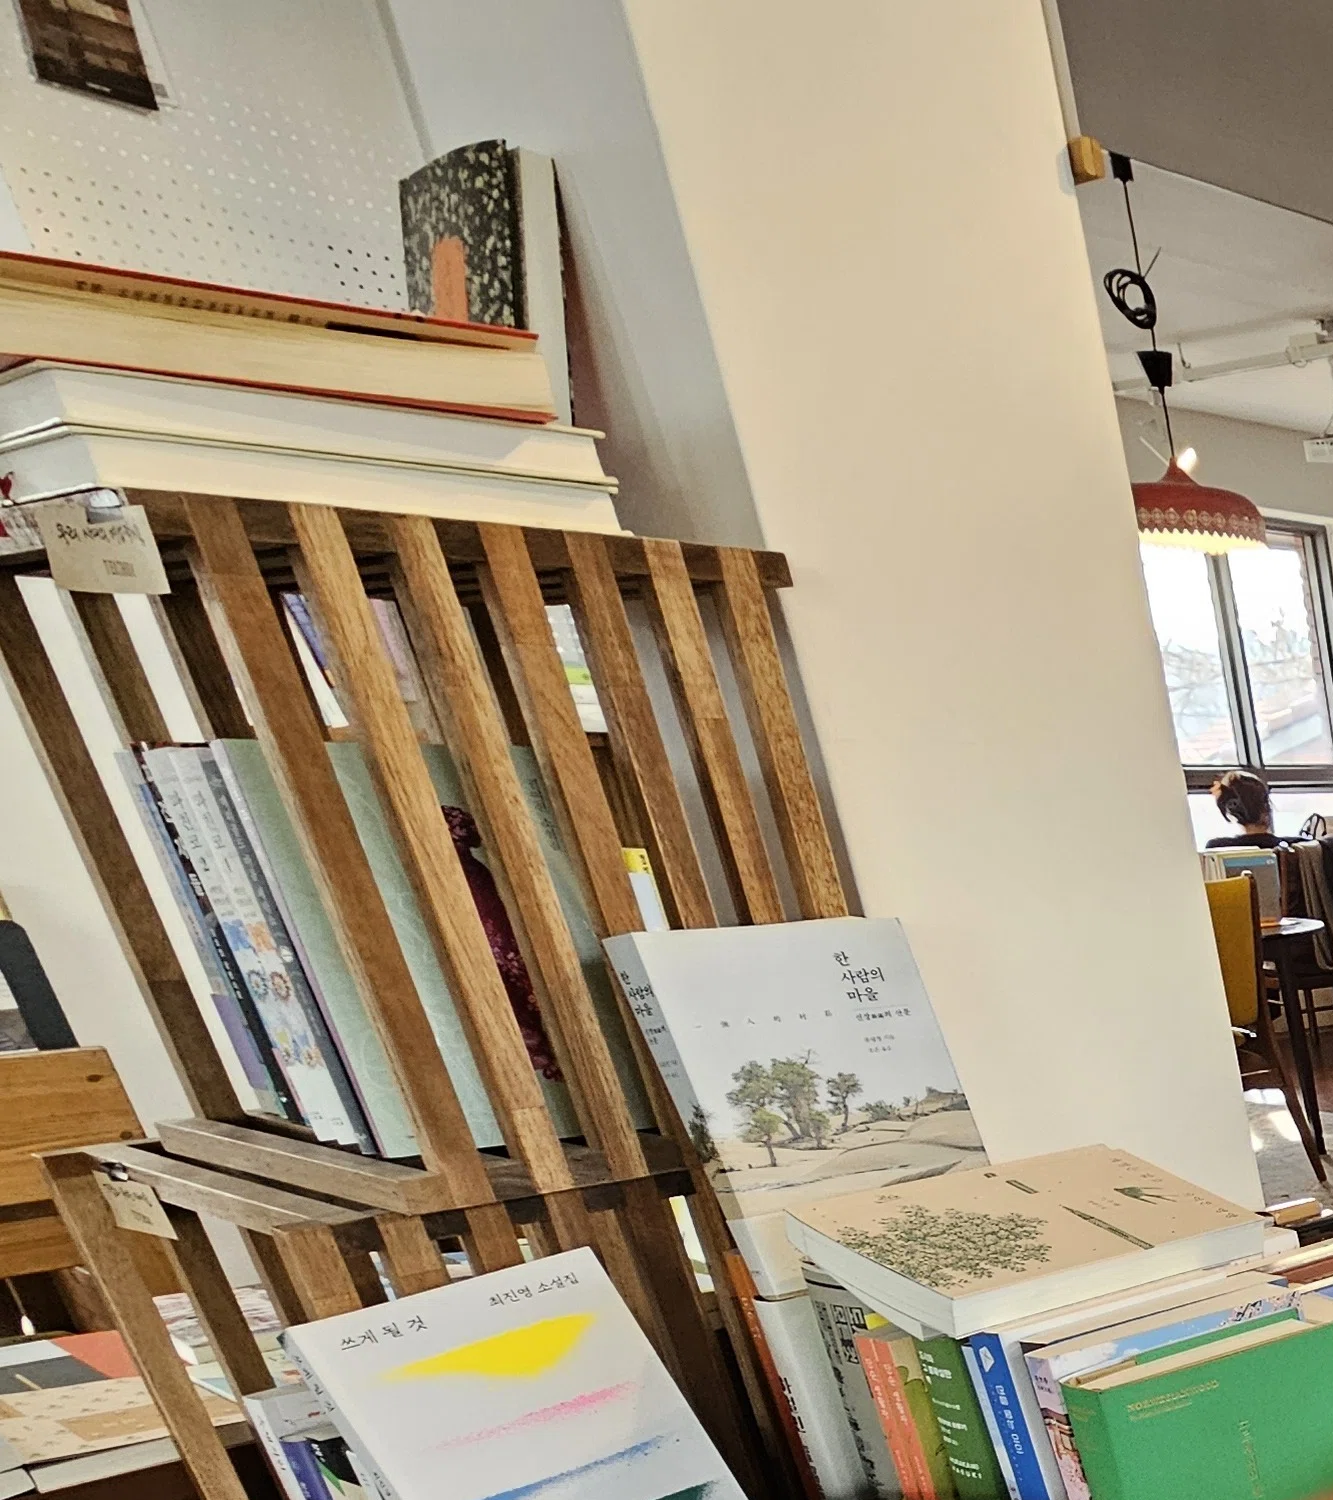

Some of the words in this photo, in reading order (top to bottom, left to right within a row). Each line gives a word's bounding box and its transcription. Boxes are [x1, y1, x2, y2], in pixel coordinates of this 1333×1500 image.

[833, 951, 850, 966] 한
[841, 967, 885, 985] 사람의
[847, 987, 878, 1003] 마을
[489, 1286, 534, 1307] 최진영
[537, 1272, 580, 1294] 소설집
[340, 1329, 378, 1351] 쓰게
[383, 1321, 404, 1338] 될
[407, 1315, 428, 1332] 것
